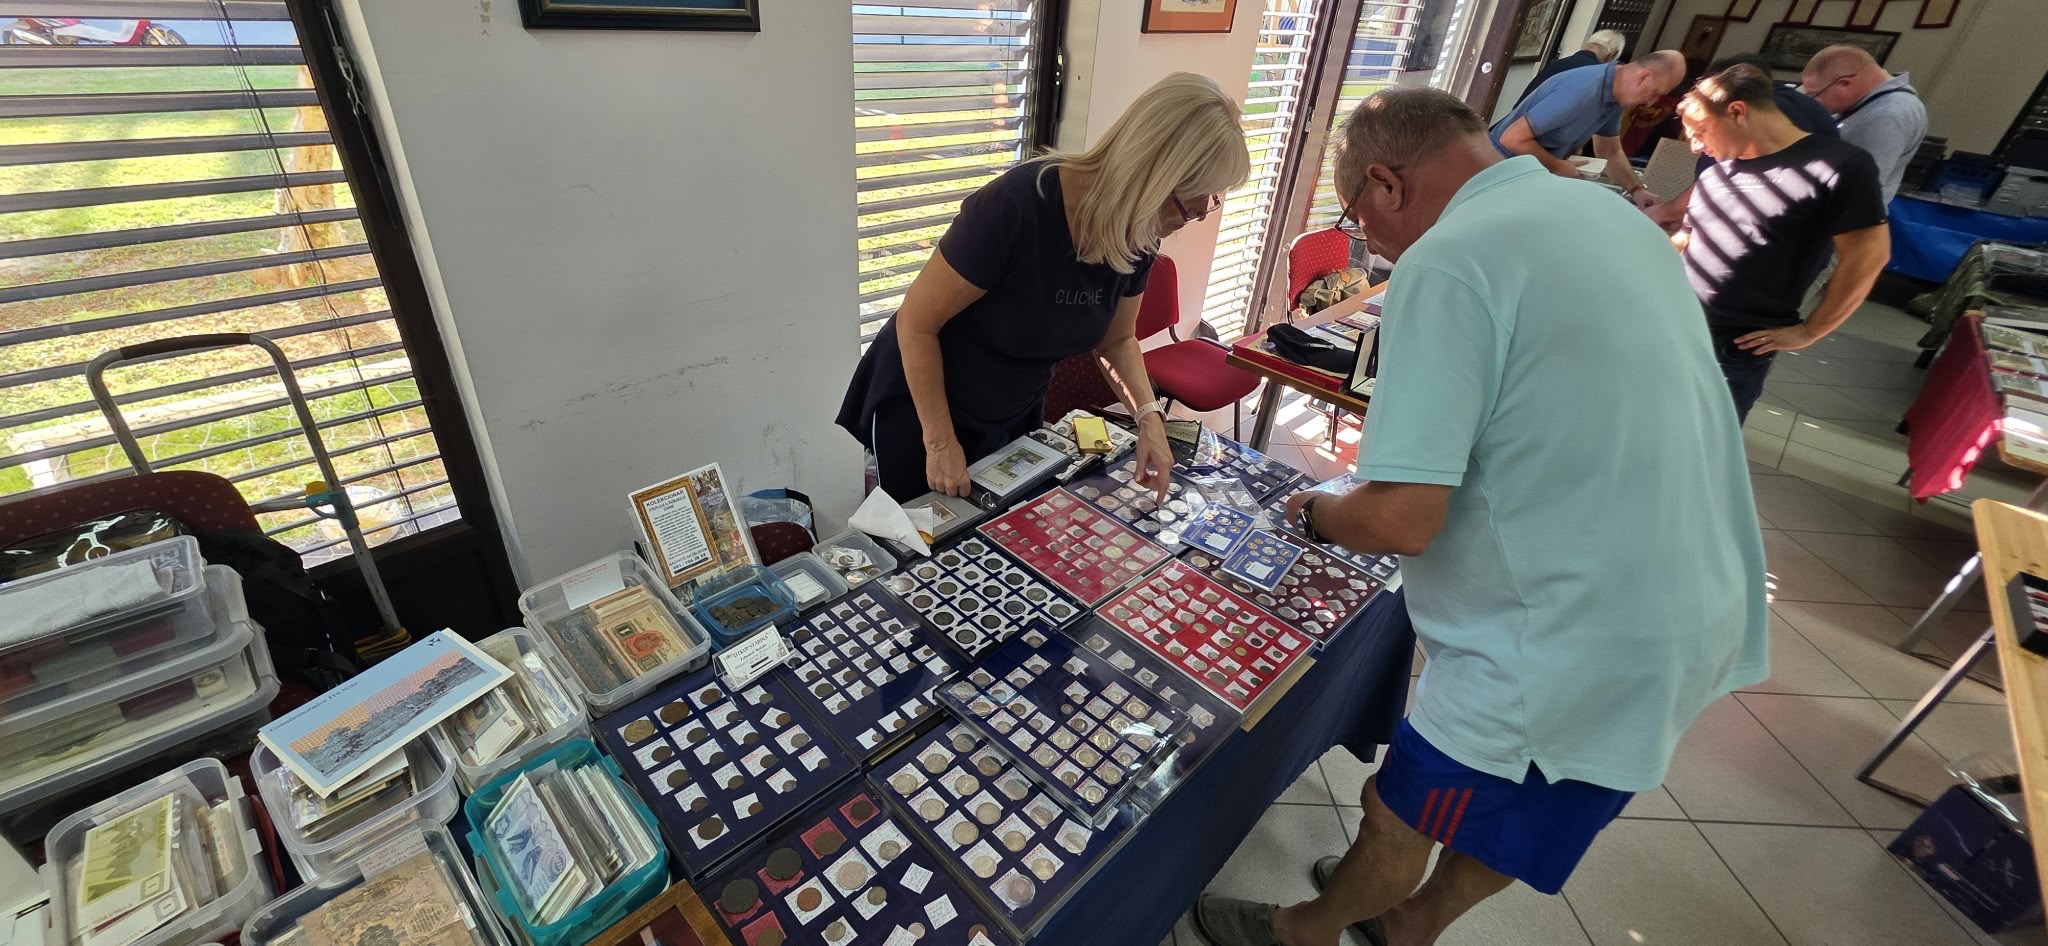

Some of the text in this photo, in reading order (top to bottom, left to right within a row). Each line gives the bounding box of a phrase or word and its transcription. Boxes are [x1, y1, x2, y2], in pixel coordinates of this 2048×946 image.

[1055, 288, 1103, 305] CLICHÉ
[646, 490, 684, 507] KOLEKCIONAR
[269, 699, 327, 732] Commemorative
[342, 682, 358, 693] Note
